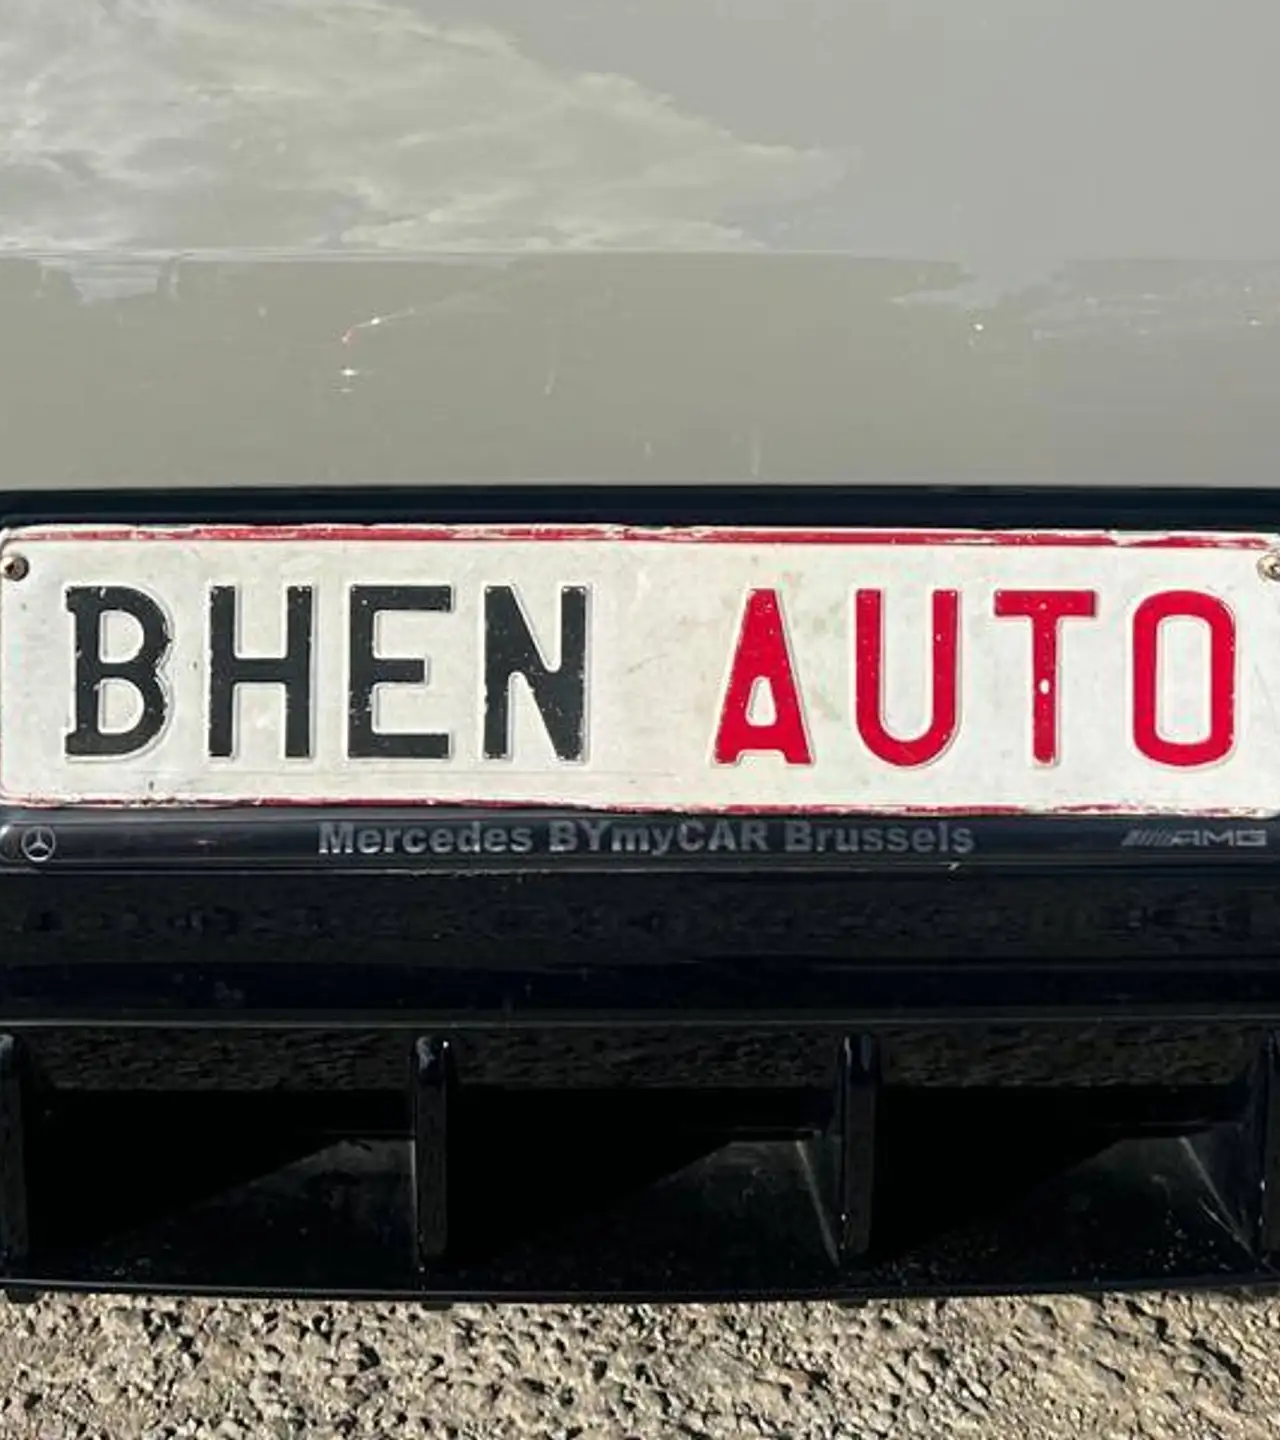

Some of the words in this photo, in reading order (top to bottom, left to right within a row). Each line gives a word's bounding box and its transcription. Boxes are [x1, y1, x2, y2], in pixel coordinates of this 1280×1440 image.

[64, 585, 590, 761] BHEN
[710, 588, 1237, 766] AUTO
[320, 820, 532, 855] Mercedes
[549, 818, 769, 857] BYmyCAR
[785, 821, 975, 853] Brussels
[1171, 829, 1268, 847] AMG
